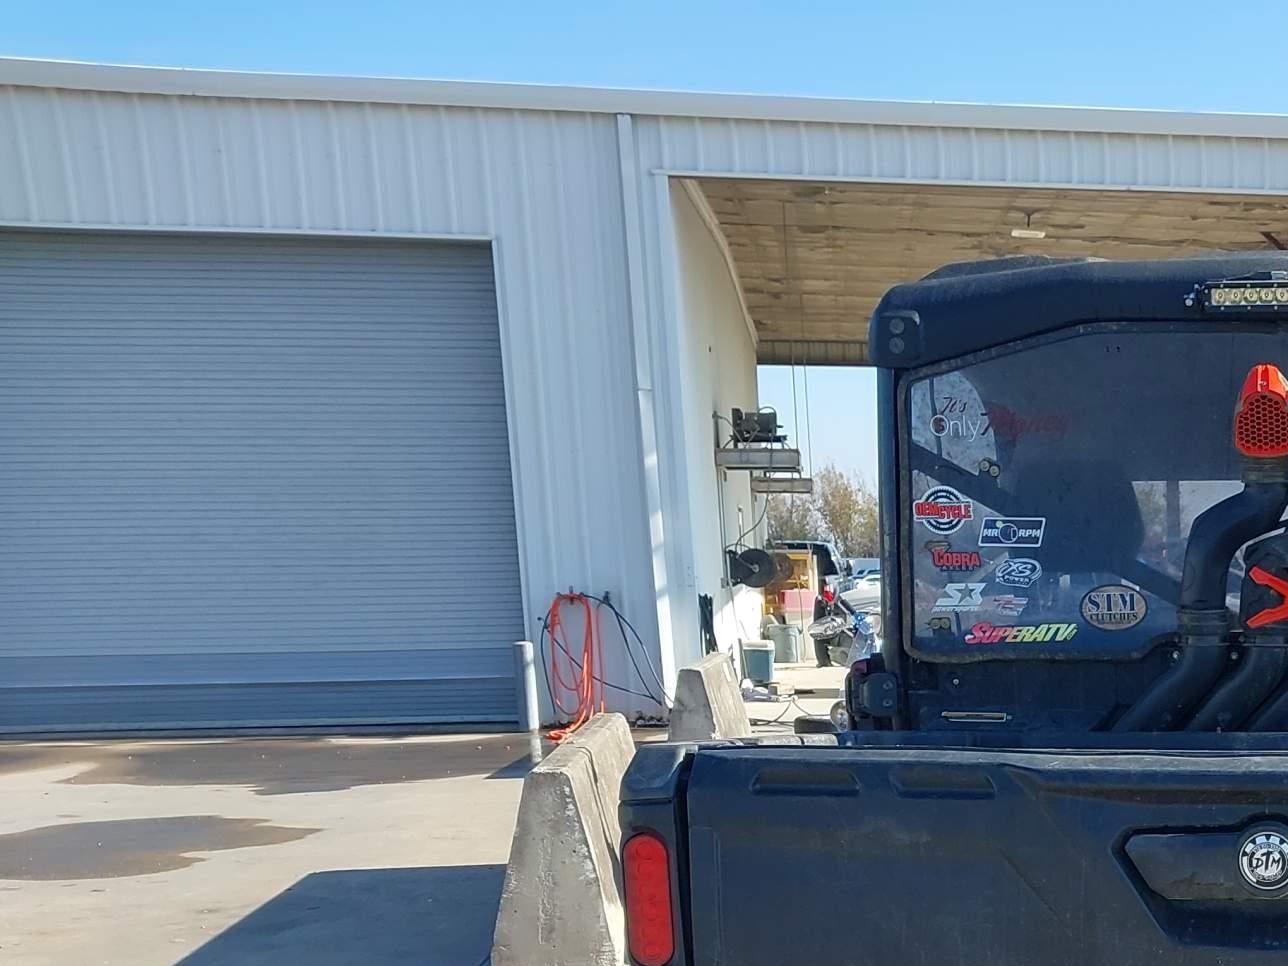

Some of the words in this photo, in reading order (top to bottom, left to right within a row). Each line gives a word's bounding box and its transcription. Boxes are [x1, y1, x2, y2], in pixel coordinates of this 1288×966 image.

[930, 414, 981, 442] Only
[983, 528, 999, 537] MR
[1019, 528, 1040, 537] RPM
[933, 549, 981, 567] COBRA
[998, 561, 1033, 576] XS
[1086, 592, 1137, 613] STM
